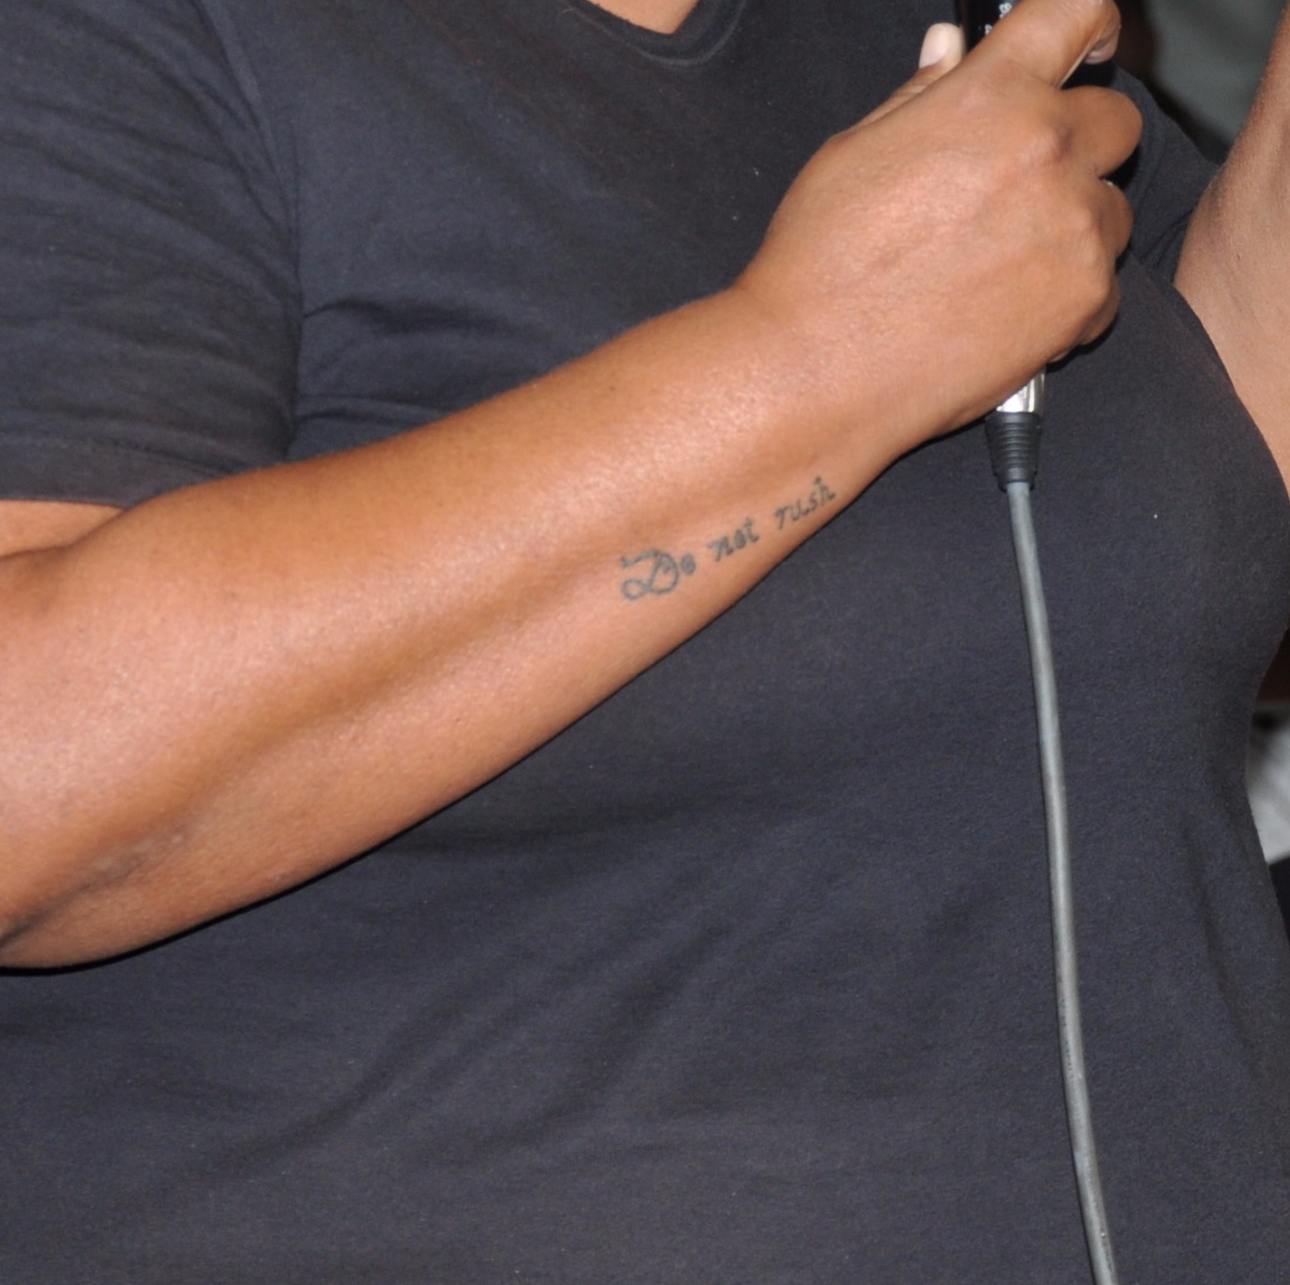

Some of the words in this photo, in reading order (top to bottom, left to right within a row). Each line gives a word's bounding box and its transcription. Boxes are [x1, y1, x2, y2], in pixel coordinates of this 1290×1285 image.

[620, 548, 696, 600] Do
[707, 518, 759, 562] not
[774, 476, 837, 529] rush
